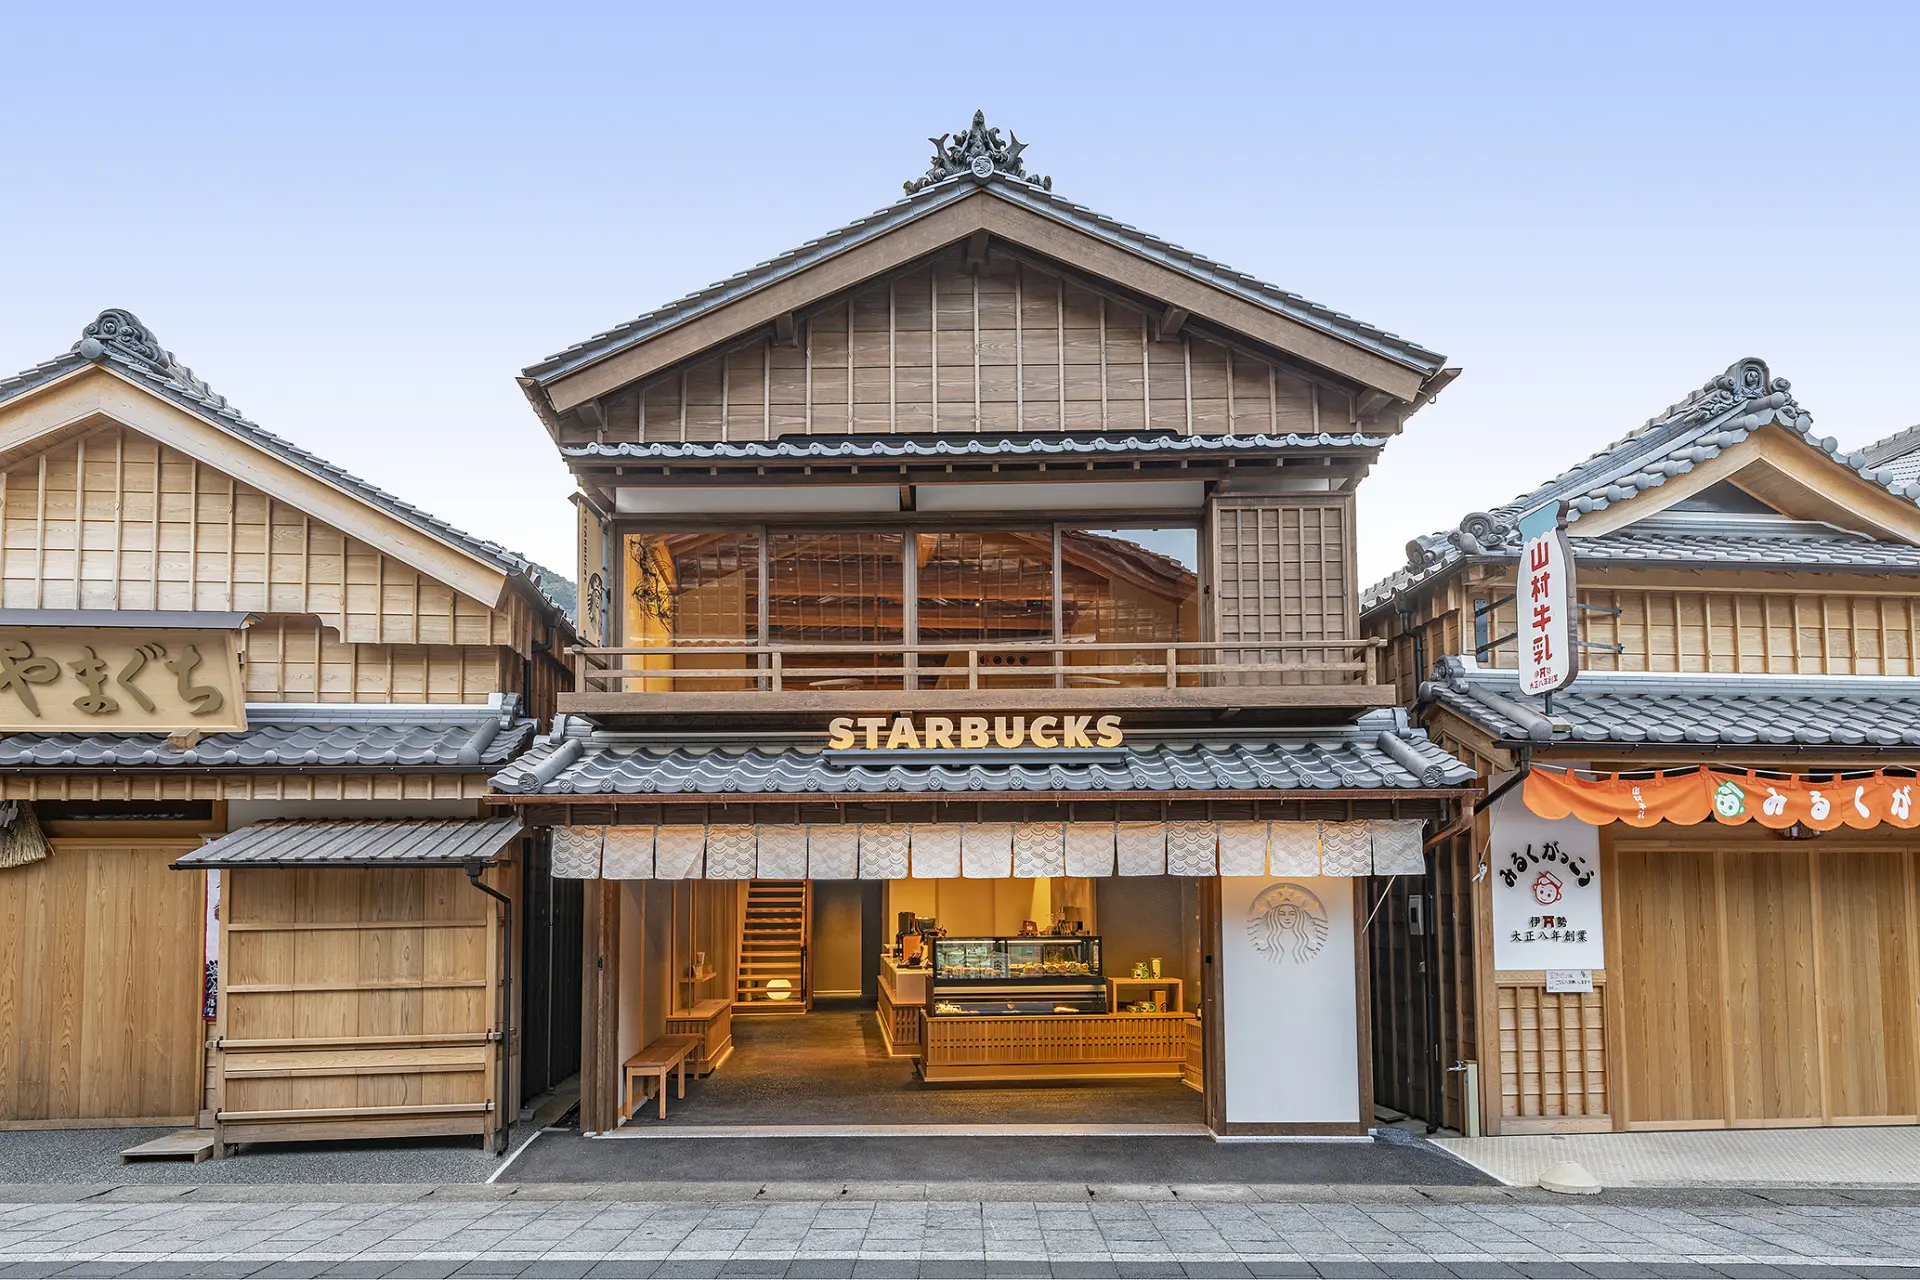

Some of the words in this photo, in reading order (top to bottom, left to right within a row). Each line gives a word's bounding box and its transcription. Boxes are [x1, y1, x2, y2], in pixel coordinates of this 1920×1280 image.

[1530, 541, 1553, 665] 山村牛乳
[0, 640, 224, 717] やまぐち
[828, 715, 1124, 750] STARBUCKS
[1762, 784, 1912, 820] みるくが
[1499, 841, 1595, 888] みるくがっこう
[1510, 930, 1588, 943] 大正八年創業
